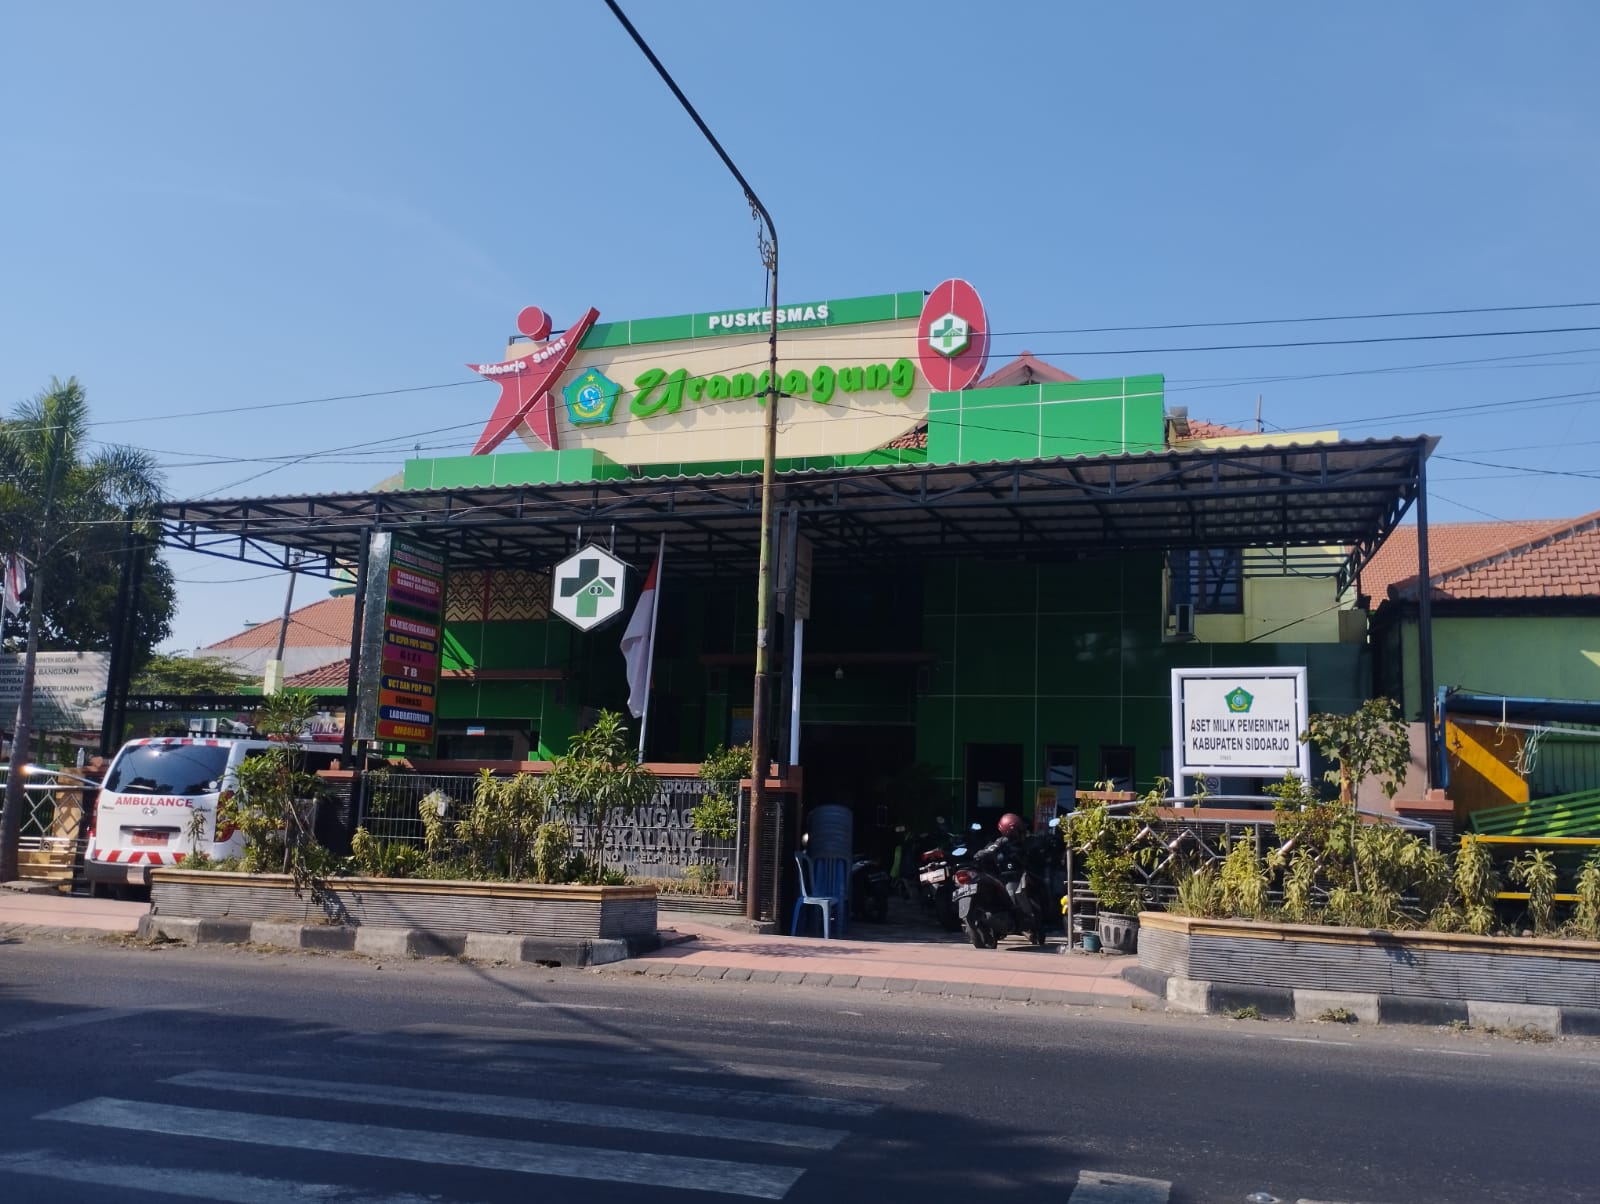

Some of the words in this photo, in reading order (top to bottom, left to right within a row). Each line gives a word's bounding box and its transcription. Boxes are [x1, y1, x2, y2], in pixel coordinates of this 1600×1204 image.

[708, 304, 828, 329] PUSKESMAS
[479, 360, 527, 374] Sidoarjo
[532, 337, 567, 364] Sehat
[629, 356, 914, 417] Urangagung
[1191, 719, 1210, 731] ASET
[1213, 719, 1235, 731] MILIK
[1238, 719, 1290, 731] PEMERINTAH
[1193, 737, 1243, 750] KABUPATEN
[1246, 737, 1289, 750] SIDOARJO
[114, 796, 193, 808] AMBULANCE
